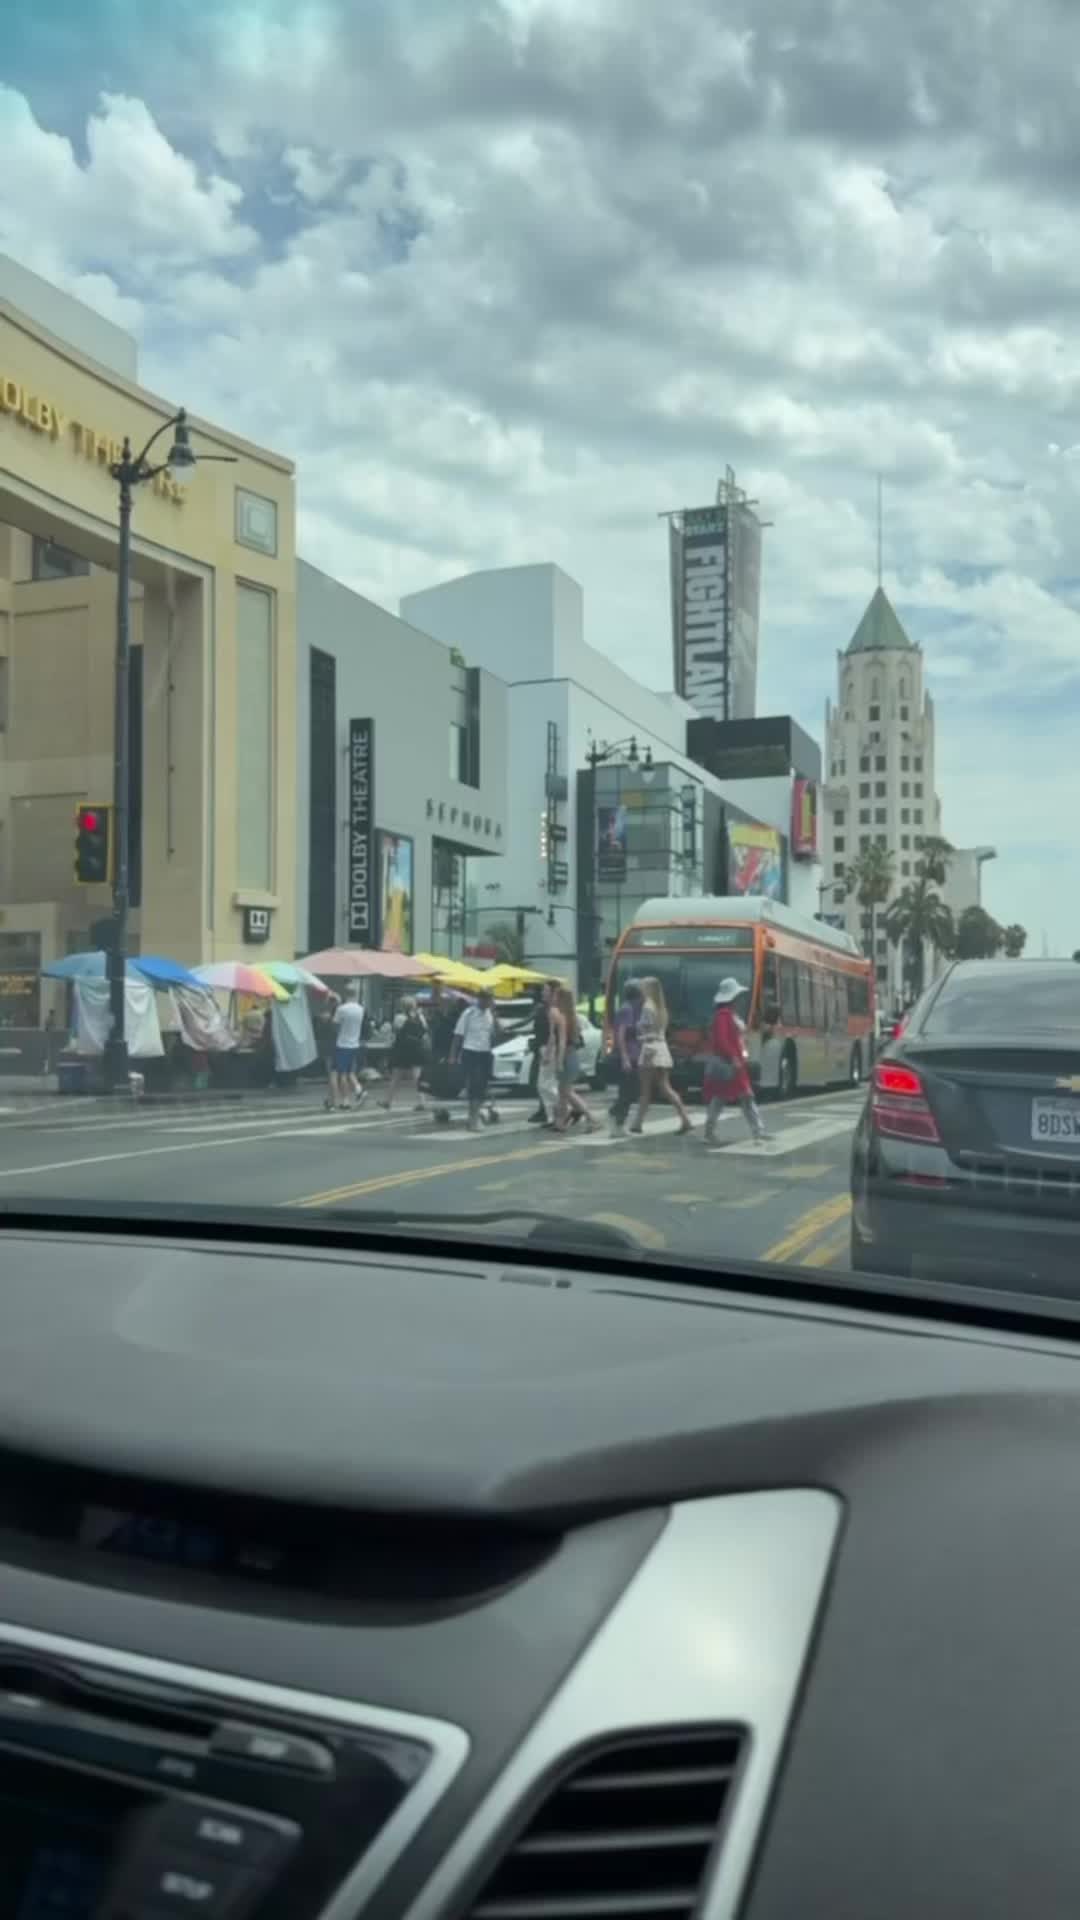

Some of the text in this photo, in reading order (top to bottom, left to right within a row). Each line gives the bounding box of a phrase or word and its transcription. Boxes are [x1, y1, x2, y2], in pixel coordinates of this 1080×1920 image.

[352, 730, 369, 899] DOLBY THEATRE
[426, 798, 502, 839] SEPHORA
